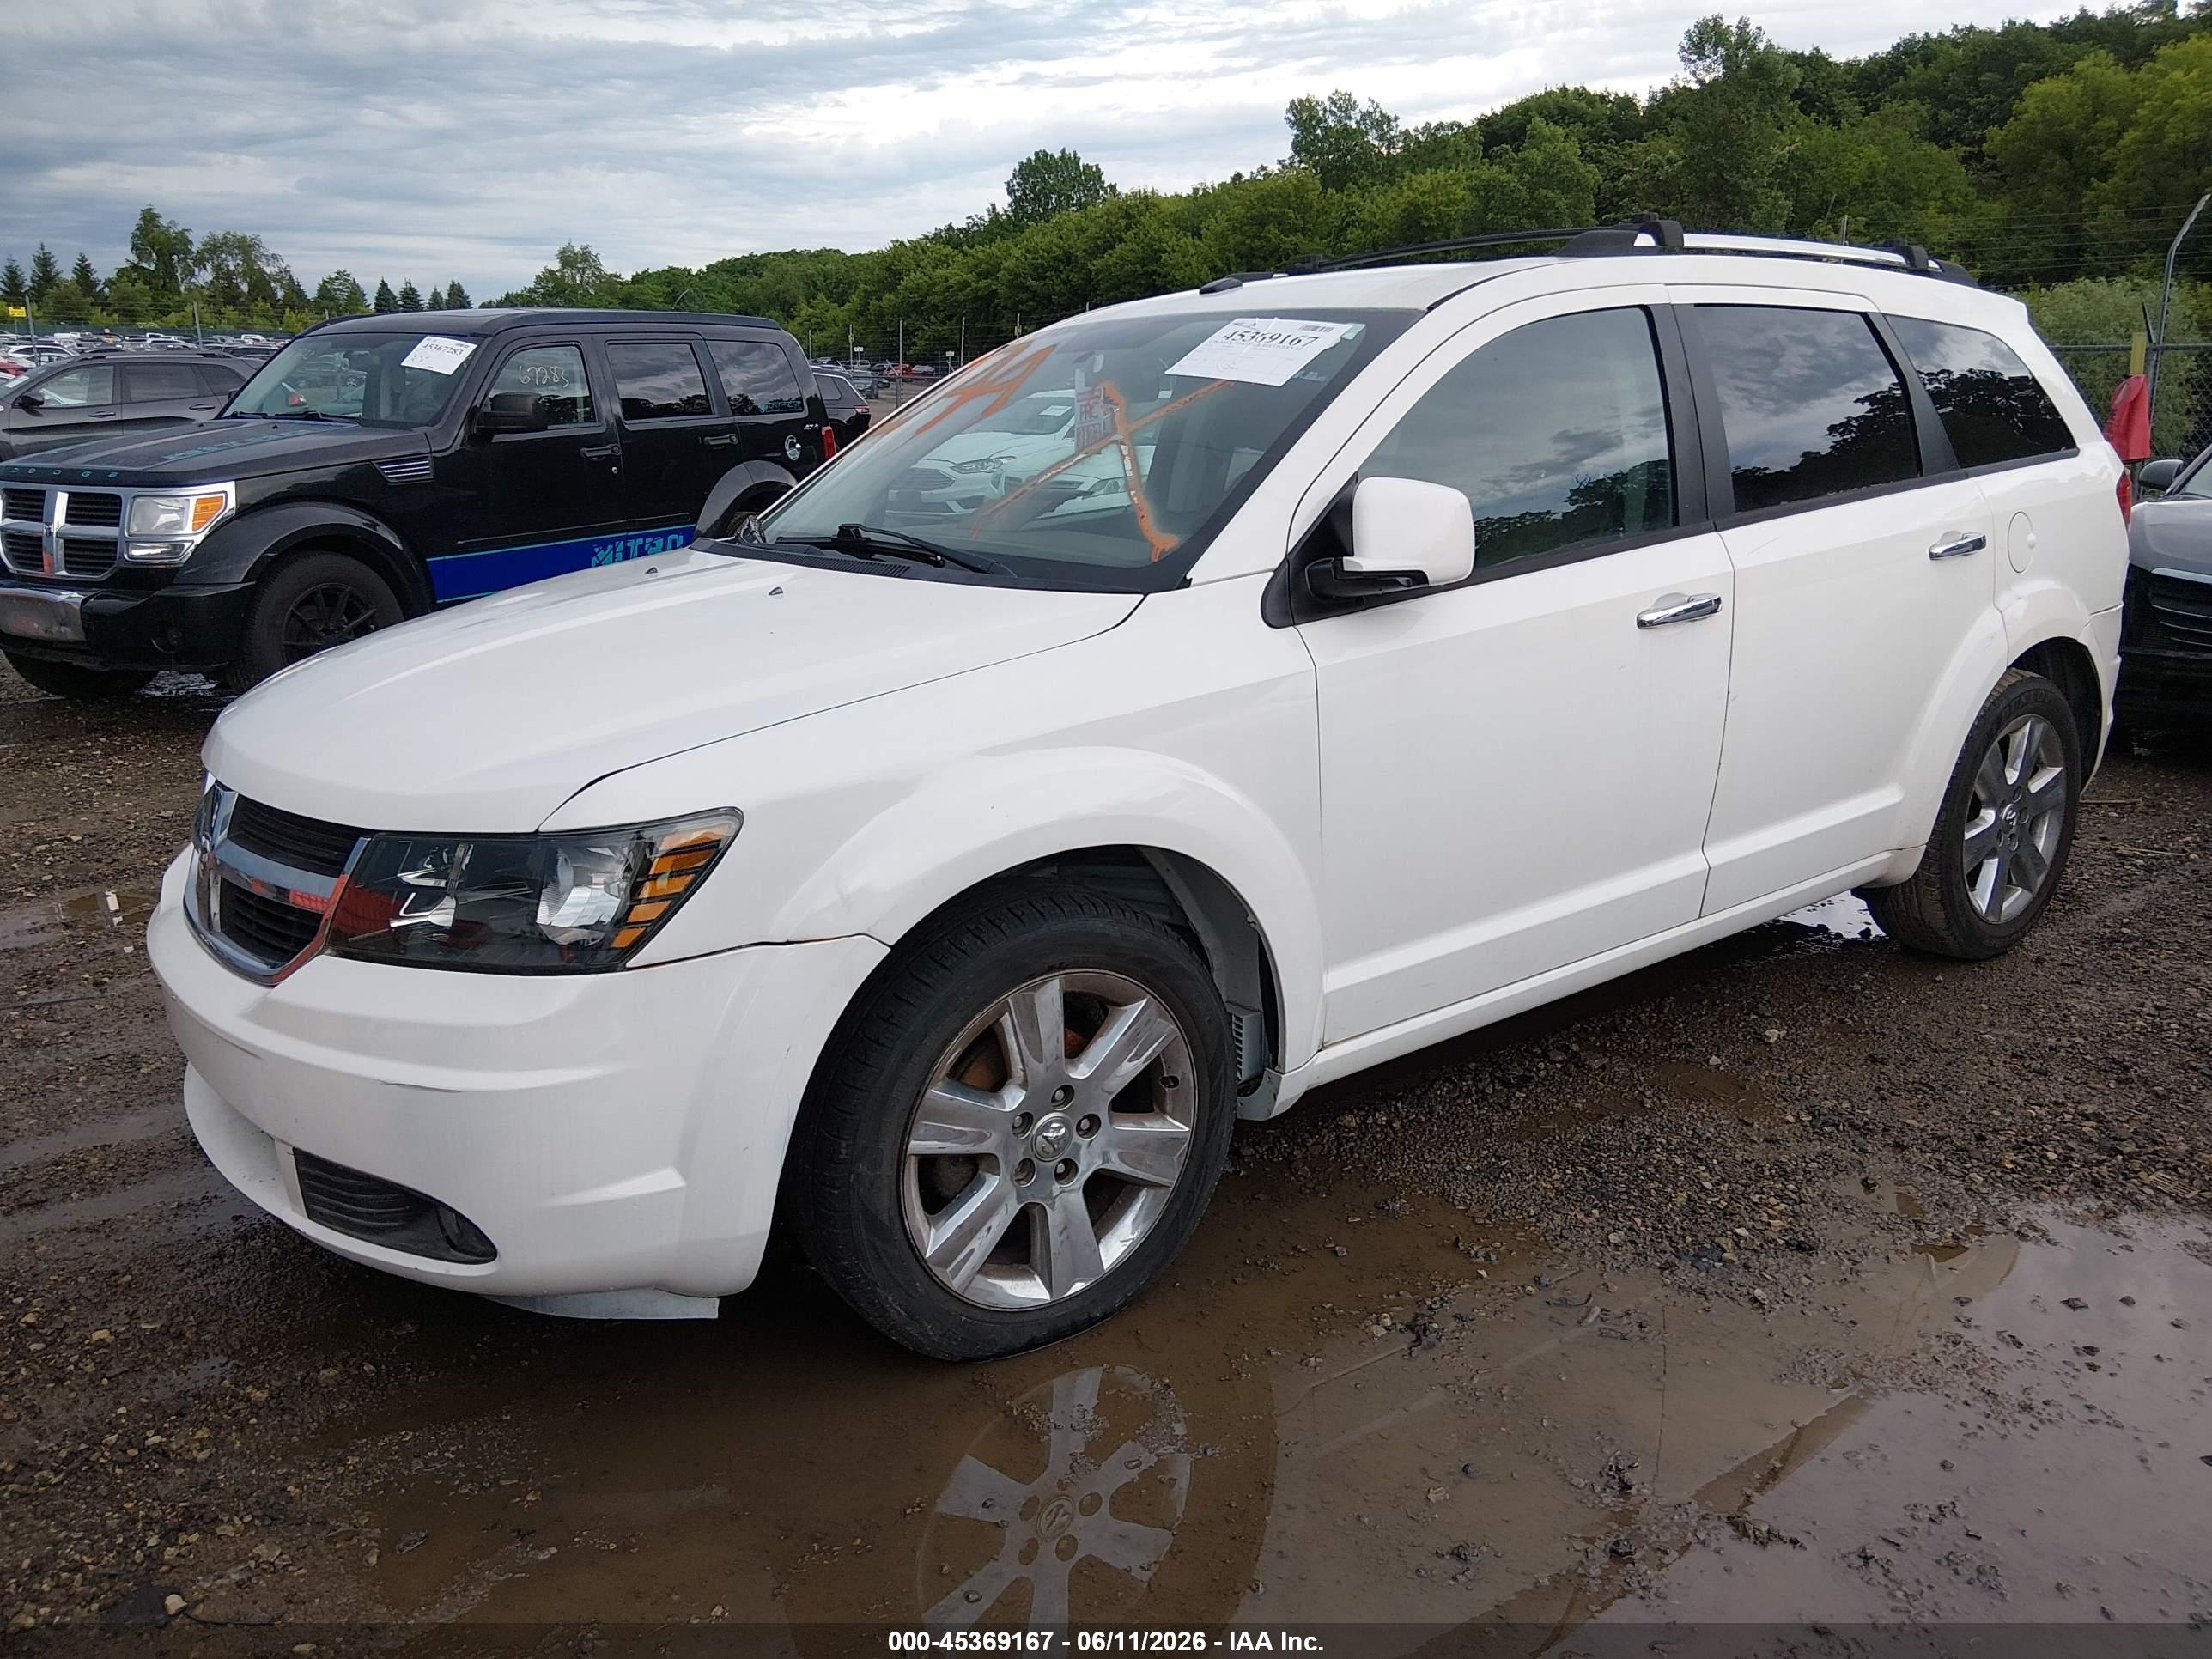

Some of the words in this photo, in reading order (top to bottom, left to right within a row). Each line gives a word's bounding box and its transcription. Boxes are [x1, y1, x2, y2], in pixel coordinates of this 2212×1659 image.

[1223, 329, 1319, 349] 45369167
[423, 343, 464, 356] 45367283
[519, 364, 570, 388] 67283
[11, 468, 118, 478] DODGE
